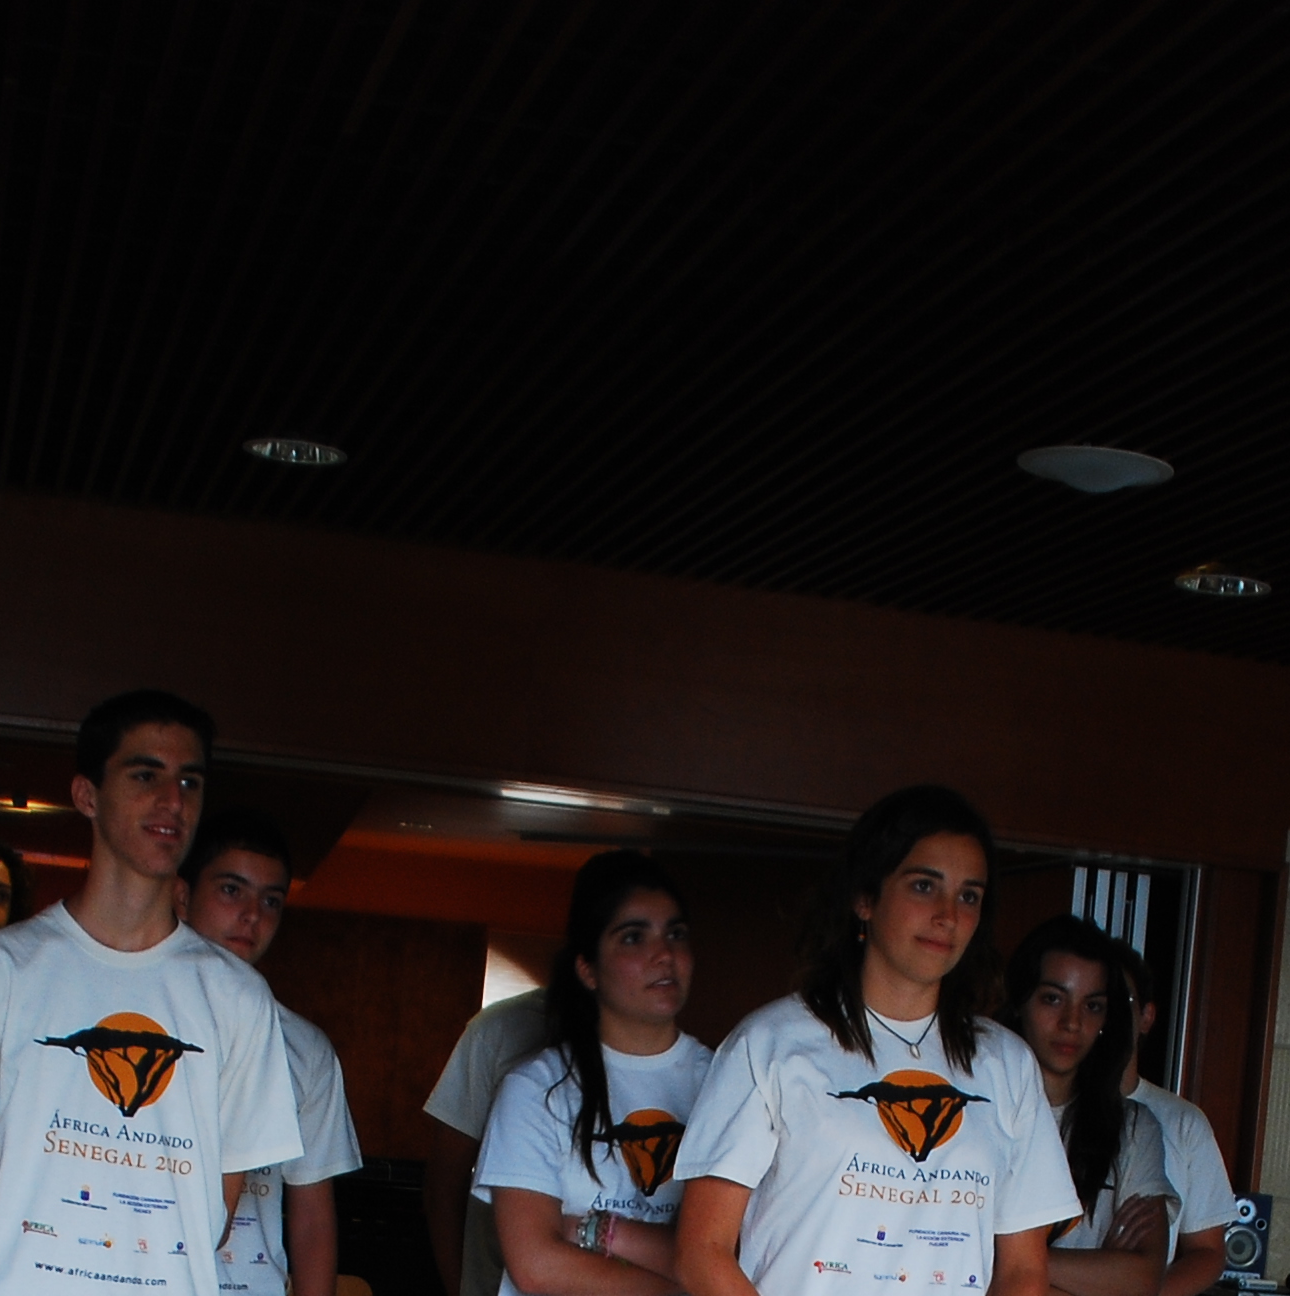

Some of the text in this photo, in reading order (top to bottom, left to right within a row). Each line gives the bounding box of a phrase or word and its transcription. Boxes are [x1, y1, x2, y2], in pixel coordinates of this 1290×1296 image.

[49, 1109, 194, 1149] ÁFRICA ANDANDO
[43, 1130, 147, 1169] SENEGAL
[846, 1152, 990, 1187] ÁFRICA ANDANDO
[591, 1191, 642, 1211] ÁFRICA
[839, 1173, 942, 1205] SENEGAL
[34, 1261, 167, 1286] www.africaandando.com
